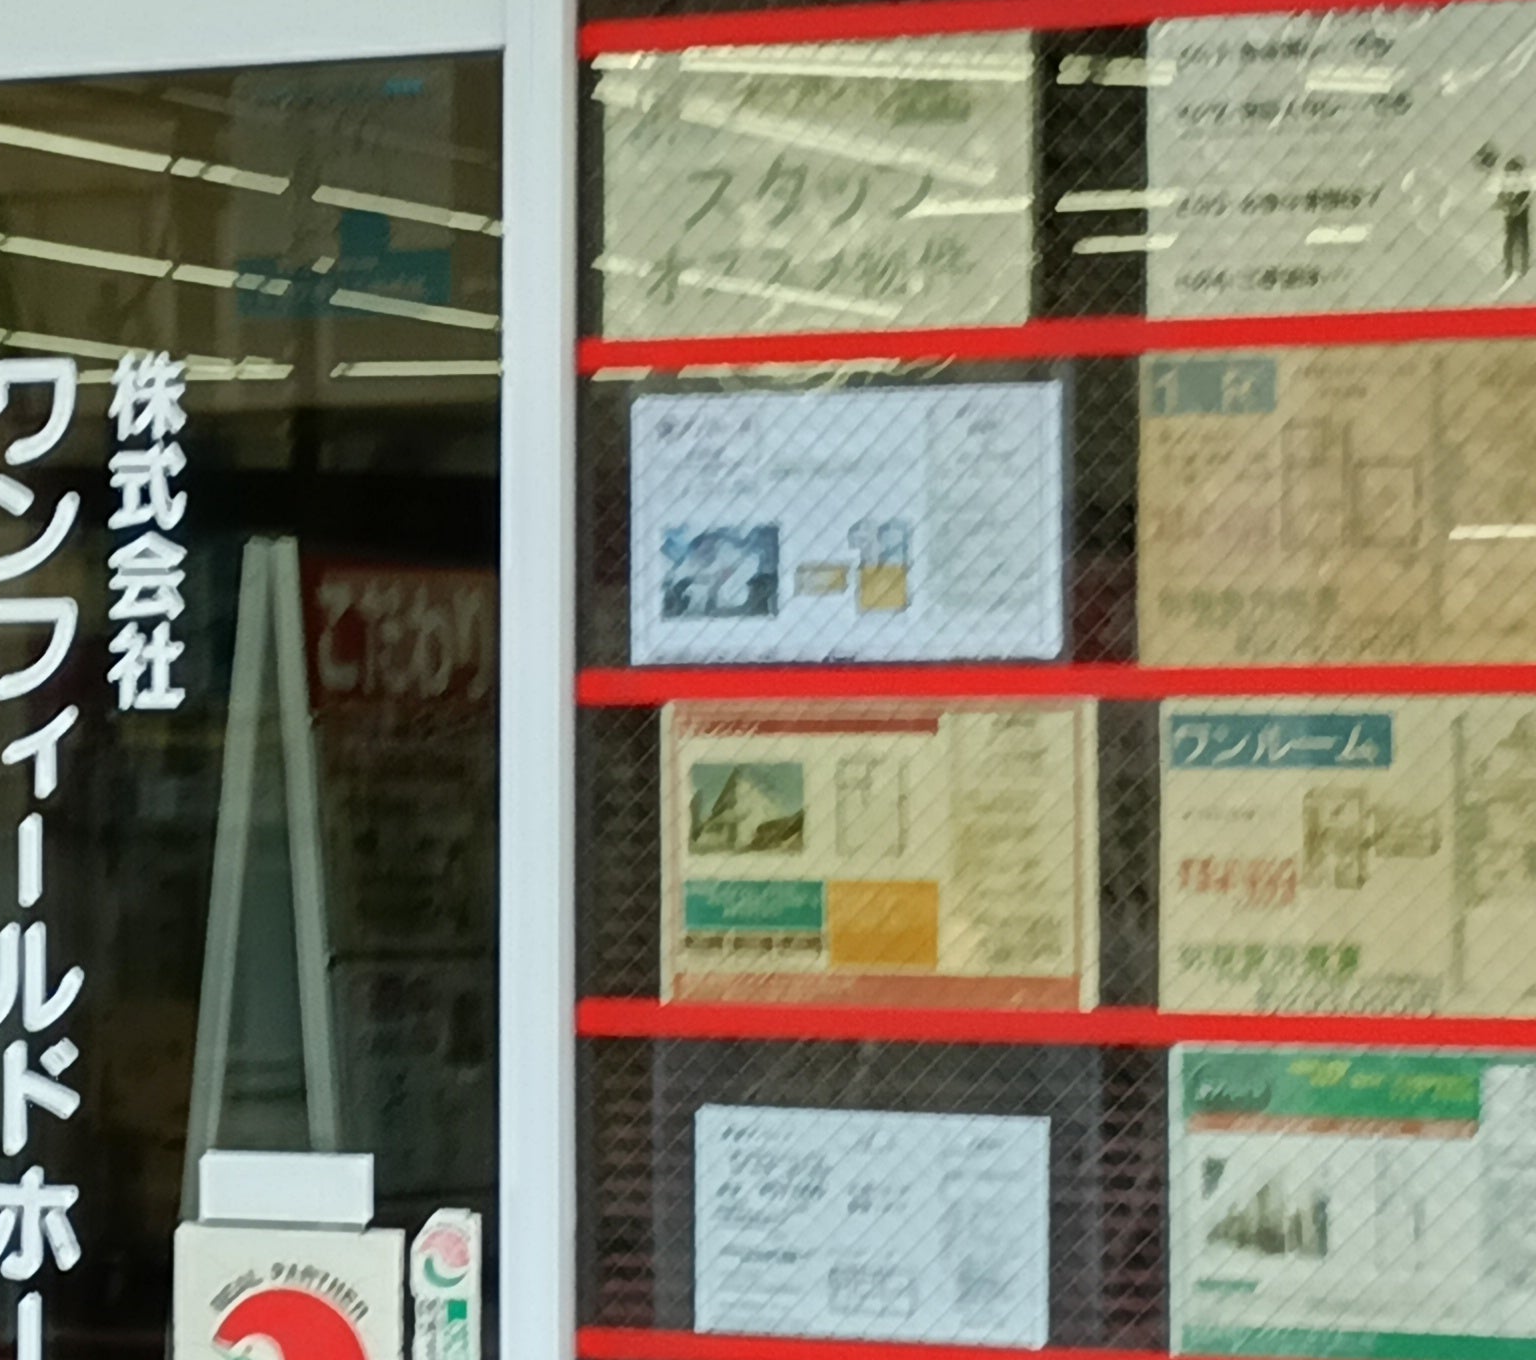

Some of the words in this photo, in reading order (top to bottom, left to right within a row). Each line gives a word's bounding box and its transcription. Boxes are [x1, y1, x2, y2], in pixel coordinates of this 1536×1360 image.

[108, 350, 186, 711] 株式会社
[1172, 719, 1380, 767] ワンルーム
